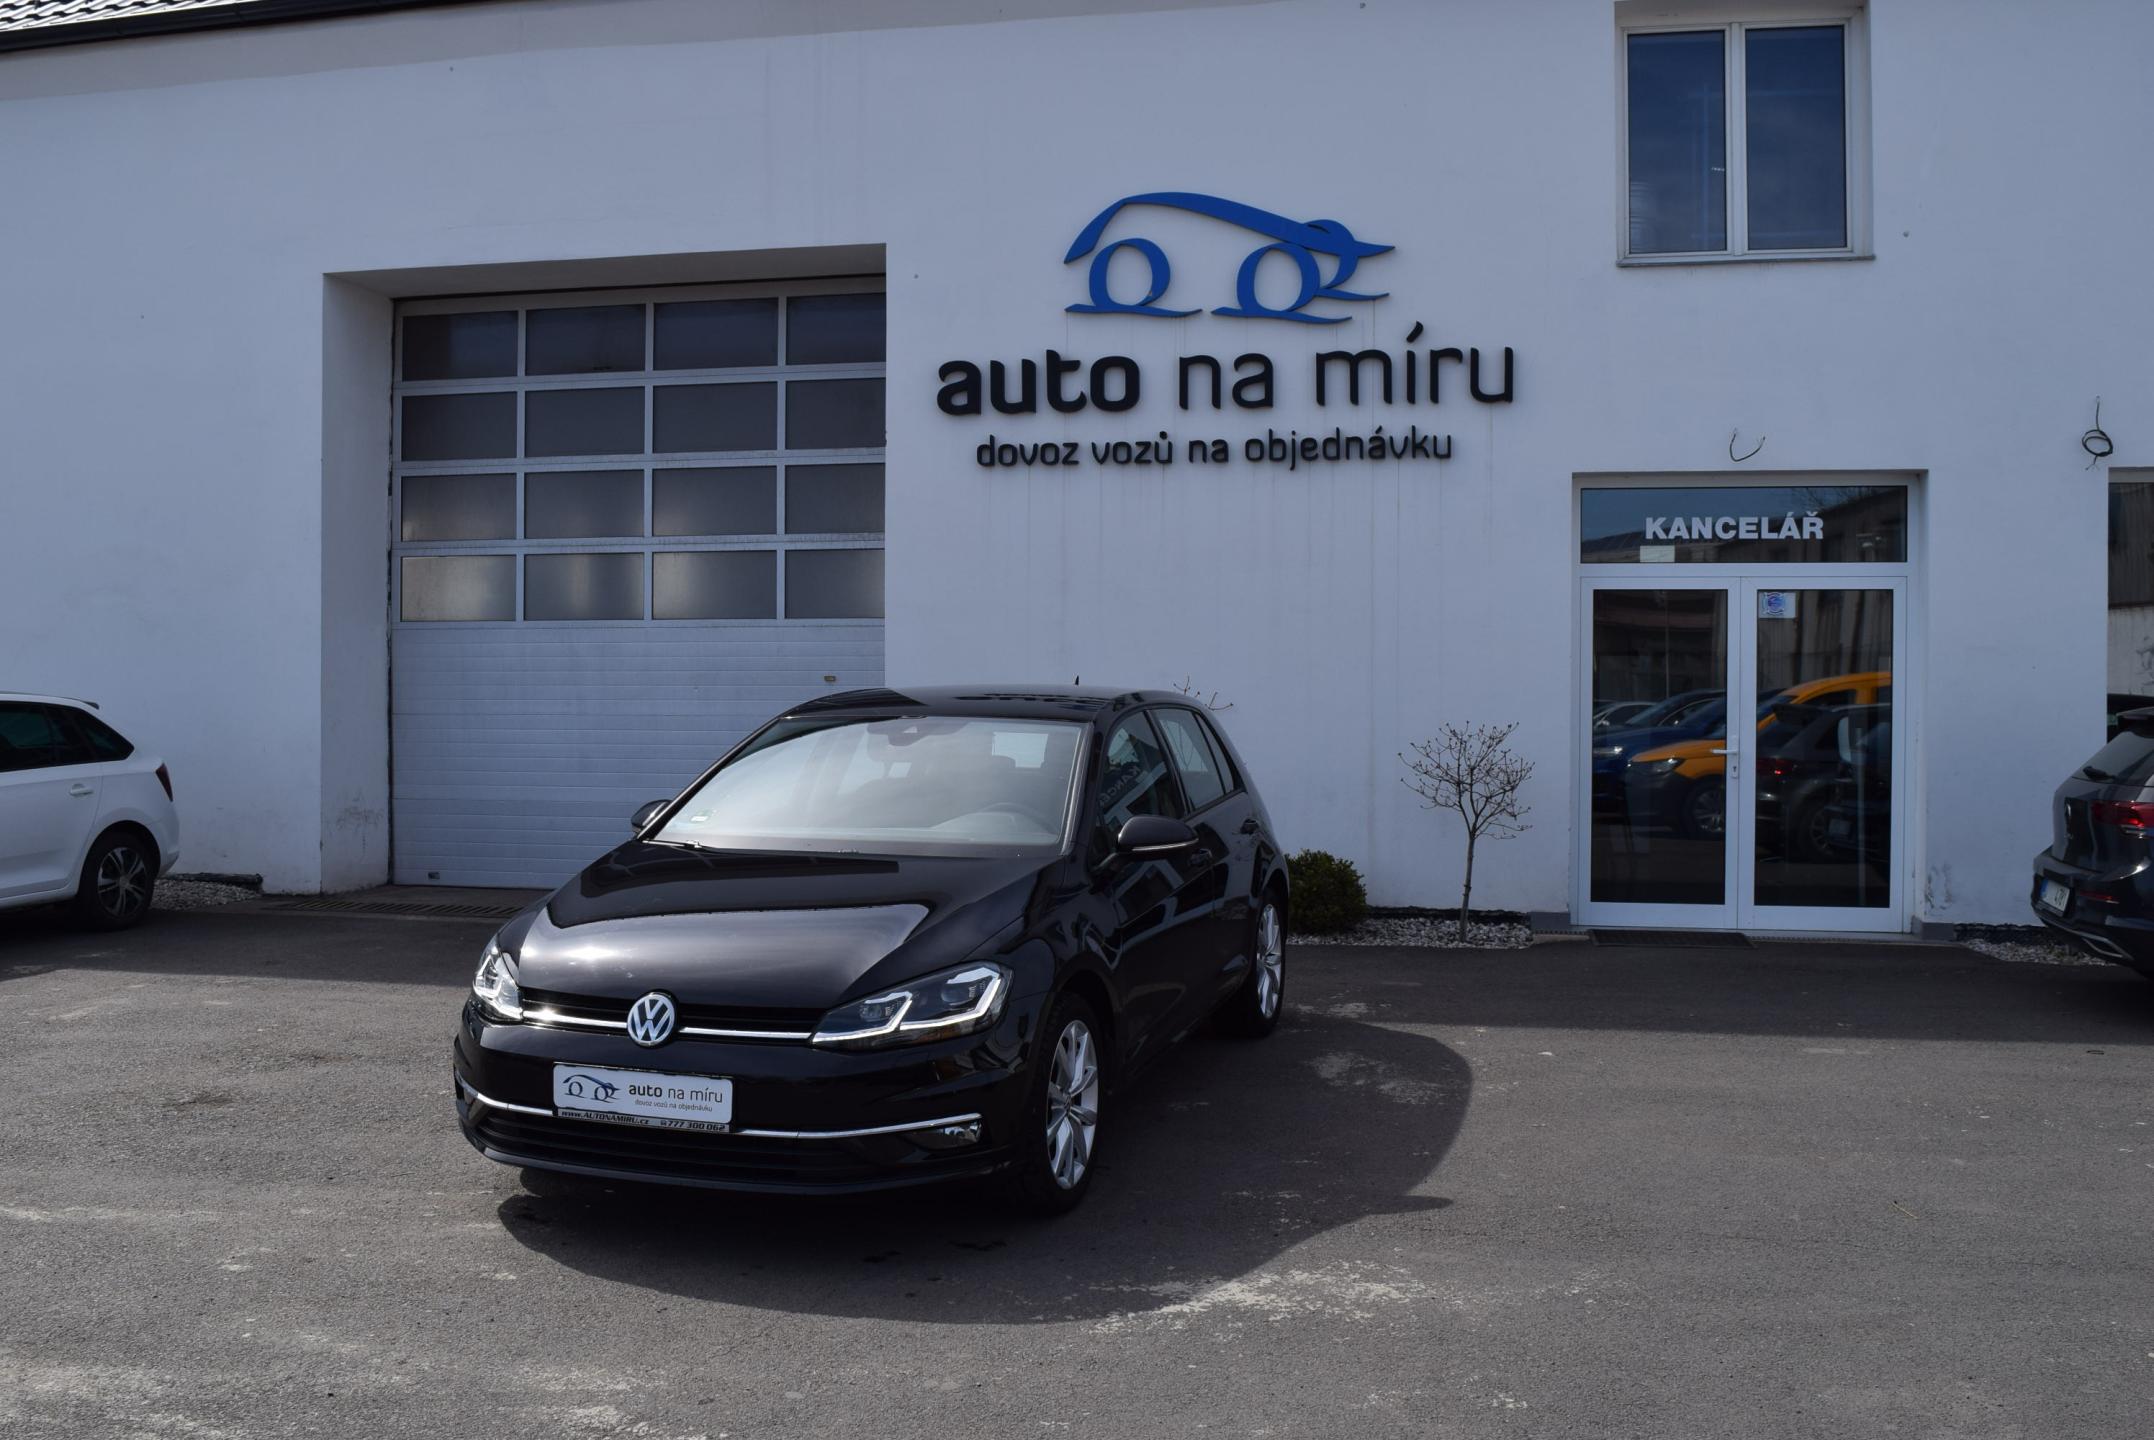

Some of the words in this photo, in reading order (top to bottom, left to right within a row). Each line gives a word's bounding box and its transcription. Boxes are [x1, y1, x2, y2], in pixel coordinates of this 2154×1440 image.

[937, 349, 1140, 416] auto
[1179, 352, 1274, 410] na
[1316, 321, 1514, 406] míru
[976, 434, 1079, 468] dovoz
[1091, 431, 1173, 466] vozů
[1188, 438, 1229, 464] na
[1245, 425, 1452, 471] objednávku
[1645, 511, 1824, 540] KANCELÁŘ
[628, 1084, 663, 1098] auto
[668, 1088, 685, 1100] na
[690, 1087, 723, 1103] míru
